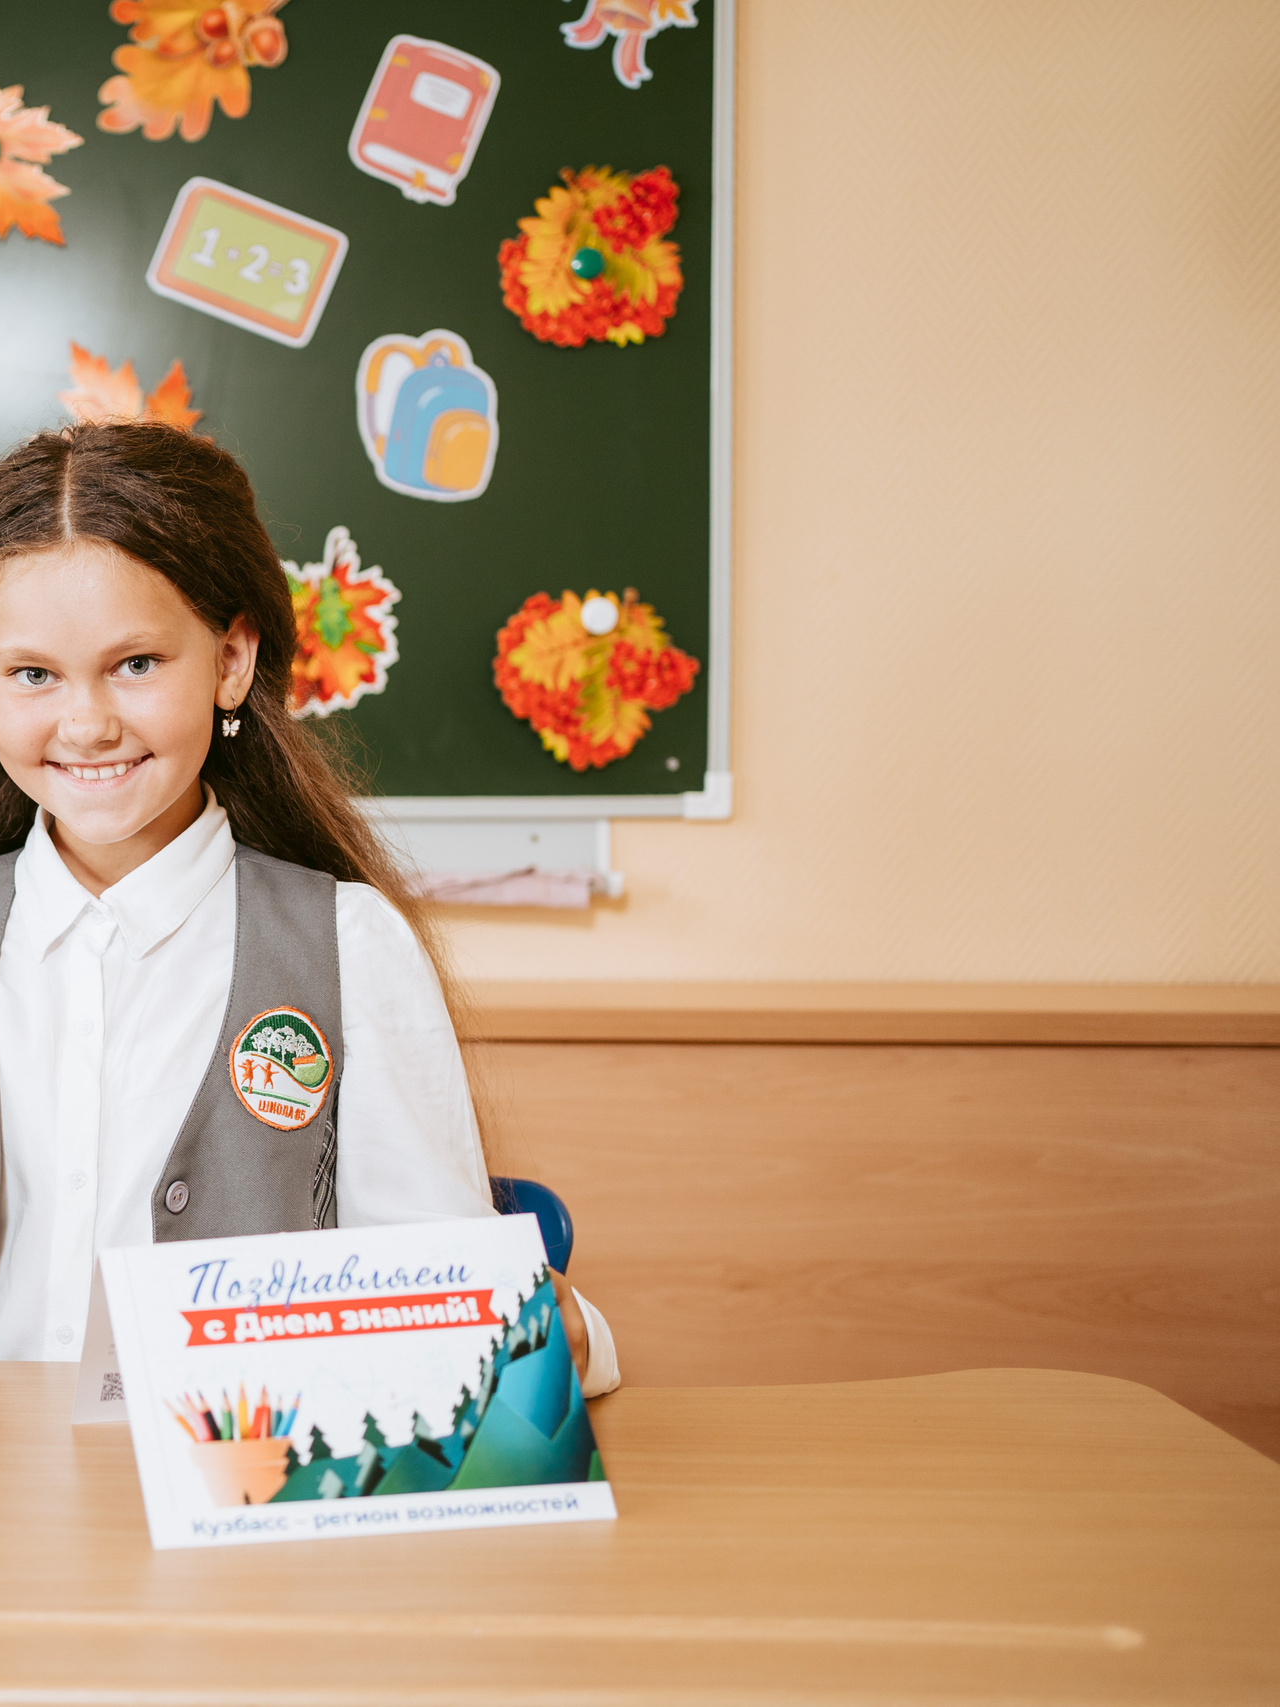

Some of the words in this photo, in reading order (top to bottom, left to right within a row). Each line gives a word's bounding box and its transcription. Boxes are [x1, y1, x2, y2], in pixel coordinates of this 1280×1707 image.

[189, 1254, 475, 1312] Поздравляем
[203, 1318, 227, 1341] с
[234, 1311, 334, 1343] Днем
[340, 1296, 481, 1332] знаний!
[192, 1513, 289, 1538] Кузбасс
[314, 1509, 399, 1531] регион
[408, 1493, 580, 1520] возможностей
